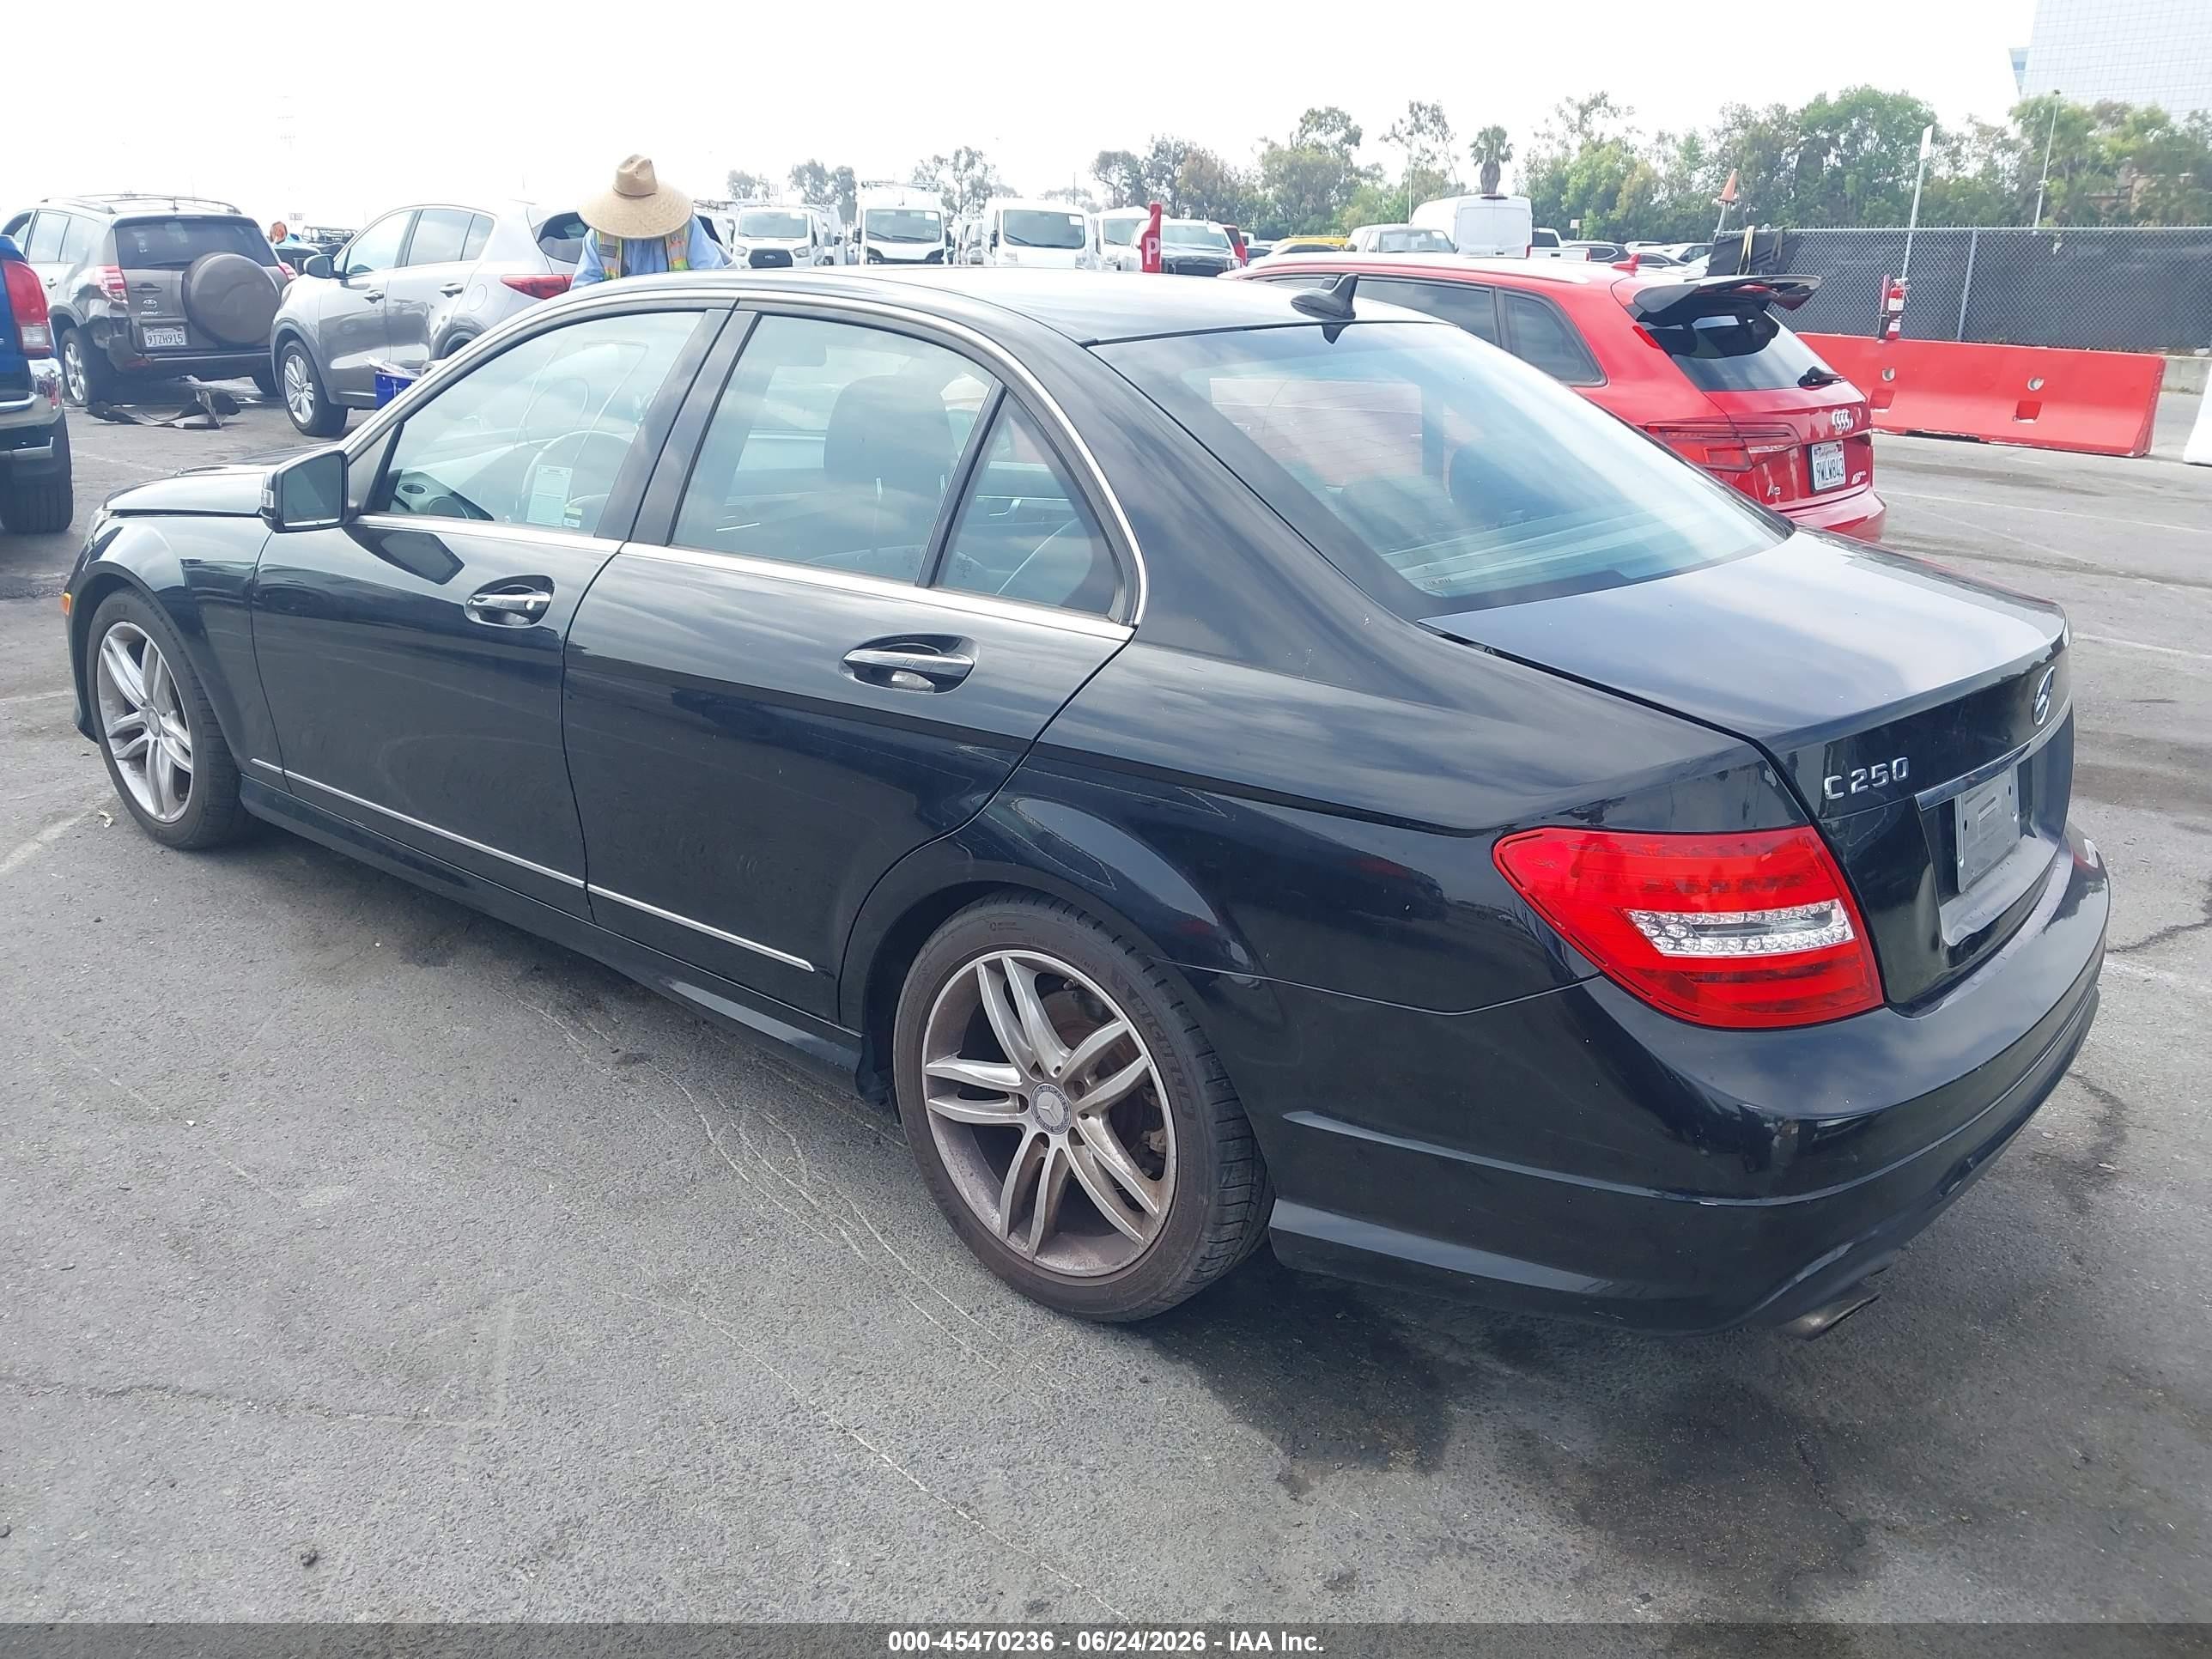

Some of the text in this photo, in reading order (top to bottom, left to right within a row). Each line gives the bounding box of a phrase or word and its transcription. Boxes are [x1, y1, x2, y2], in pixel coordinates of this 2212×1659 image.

[1146, 237, 1160, 264] P
[147, 334, 184, 344] 9TZH915
[1766, 484, 1781, 497] A3
[1824, 757, 1910, 799] C 250
